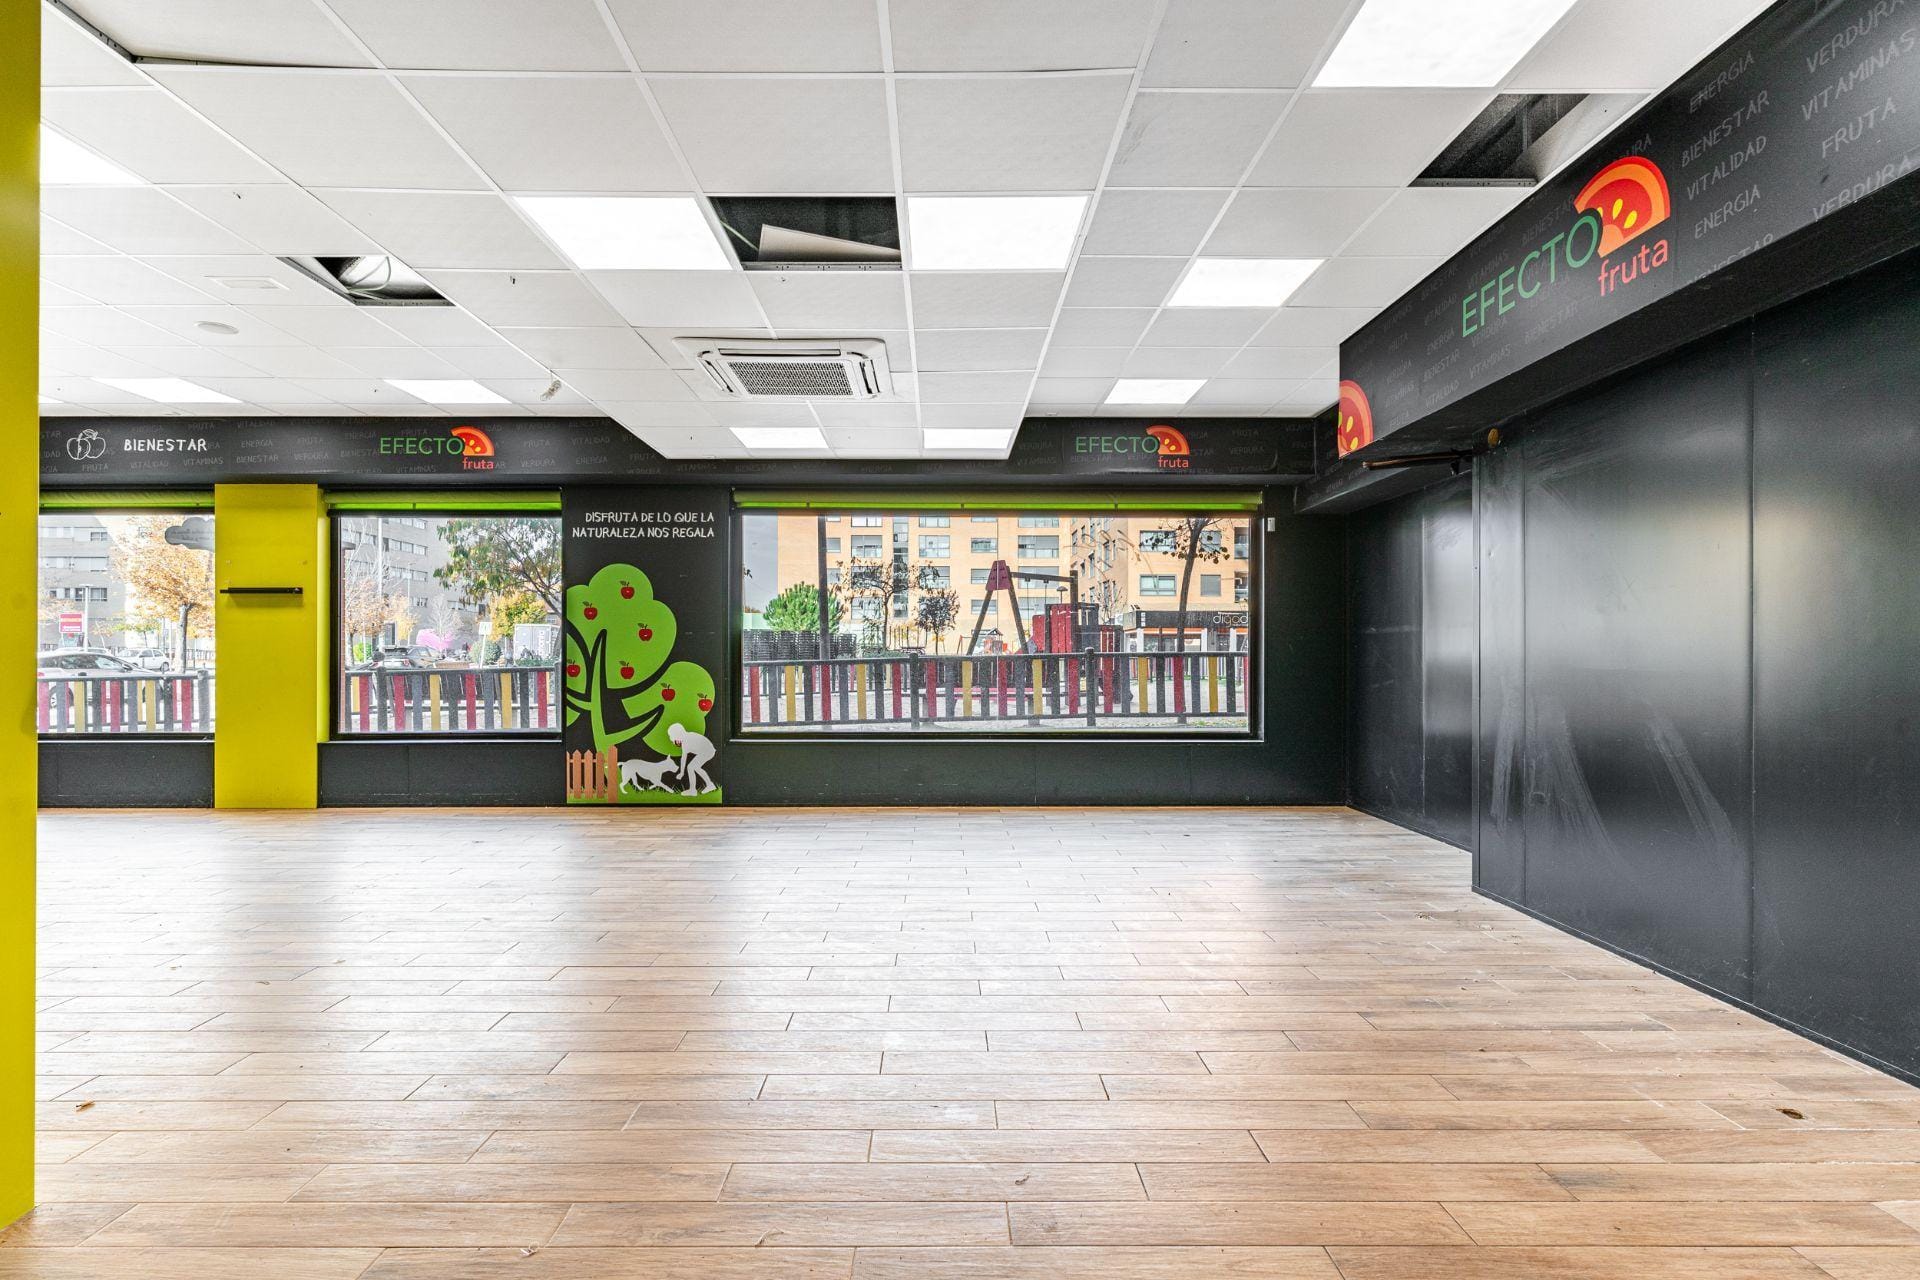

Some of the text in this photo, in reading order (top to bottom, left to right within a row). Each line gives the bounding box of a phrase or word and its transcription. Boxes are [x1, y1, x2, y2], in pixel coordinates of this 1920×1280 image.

[1689, 50, 1755, 114] ENERGIA
[1801, 28, 1917, 121] VITAMINAS
[1681, 90, 1770, 169] BIENESTAR
[1821, 96, 1897, 159] FRUTA
[1686, 135, 1767, 201] VITALIDAD
[1693, 184, 1761, 240] ENERGIA
[1461, 214, 1599, 338] EFECTO
[1597, 239, 1669, 296] fruta
[123, 437, 208, 453] BIENESTAR
[379, 437, 463, 455] EFECTO
[462, 457, 495, 471] fruta
[1076, 436, 1159, 454] EFECTO
[1158, 455, 1189, 469] fruta
[572, 527, 715, 539] NATURALEZA NOS REGALA
[585, 511, 715, 523] DISFRUTA DE LO QUE LA
